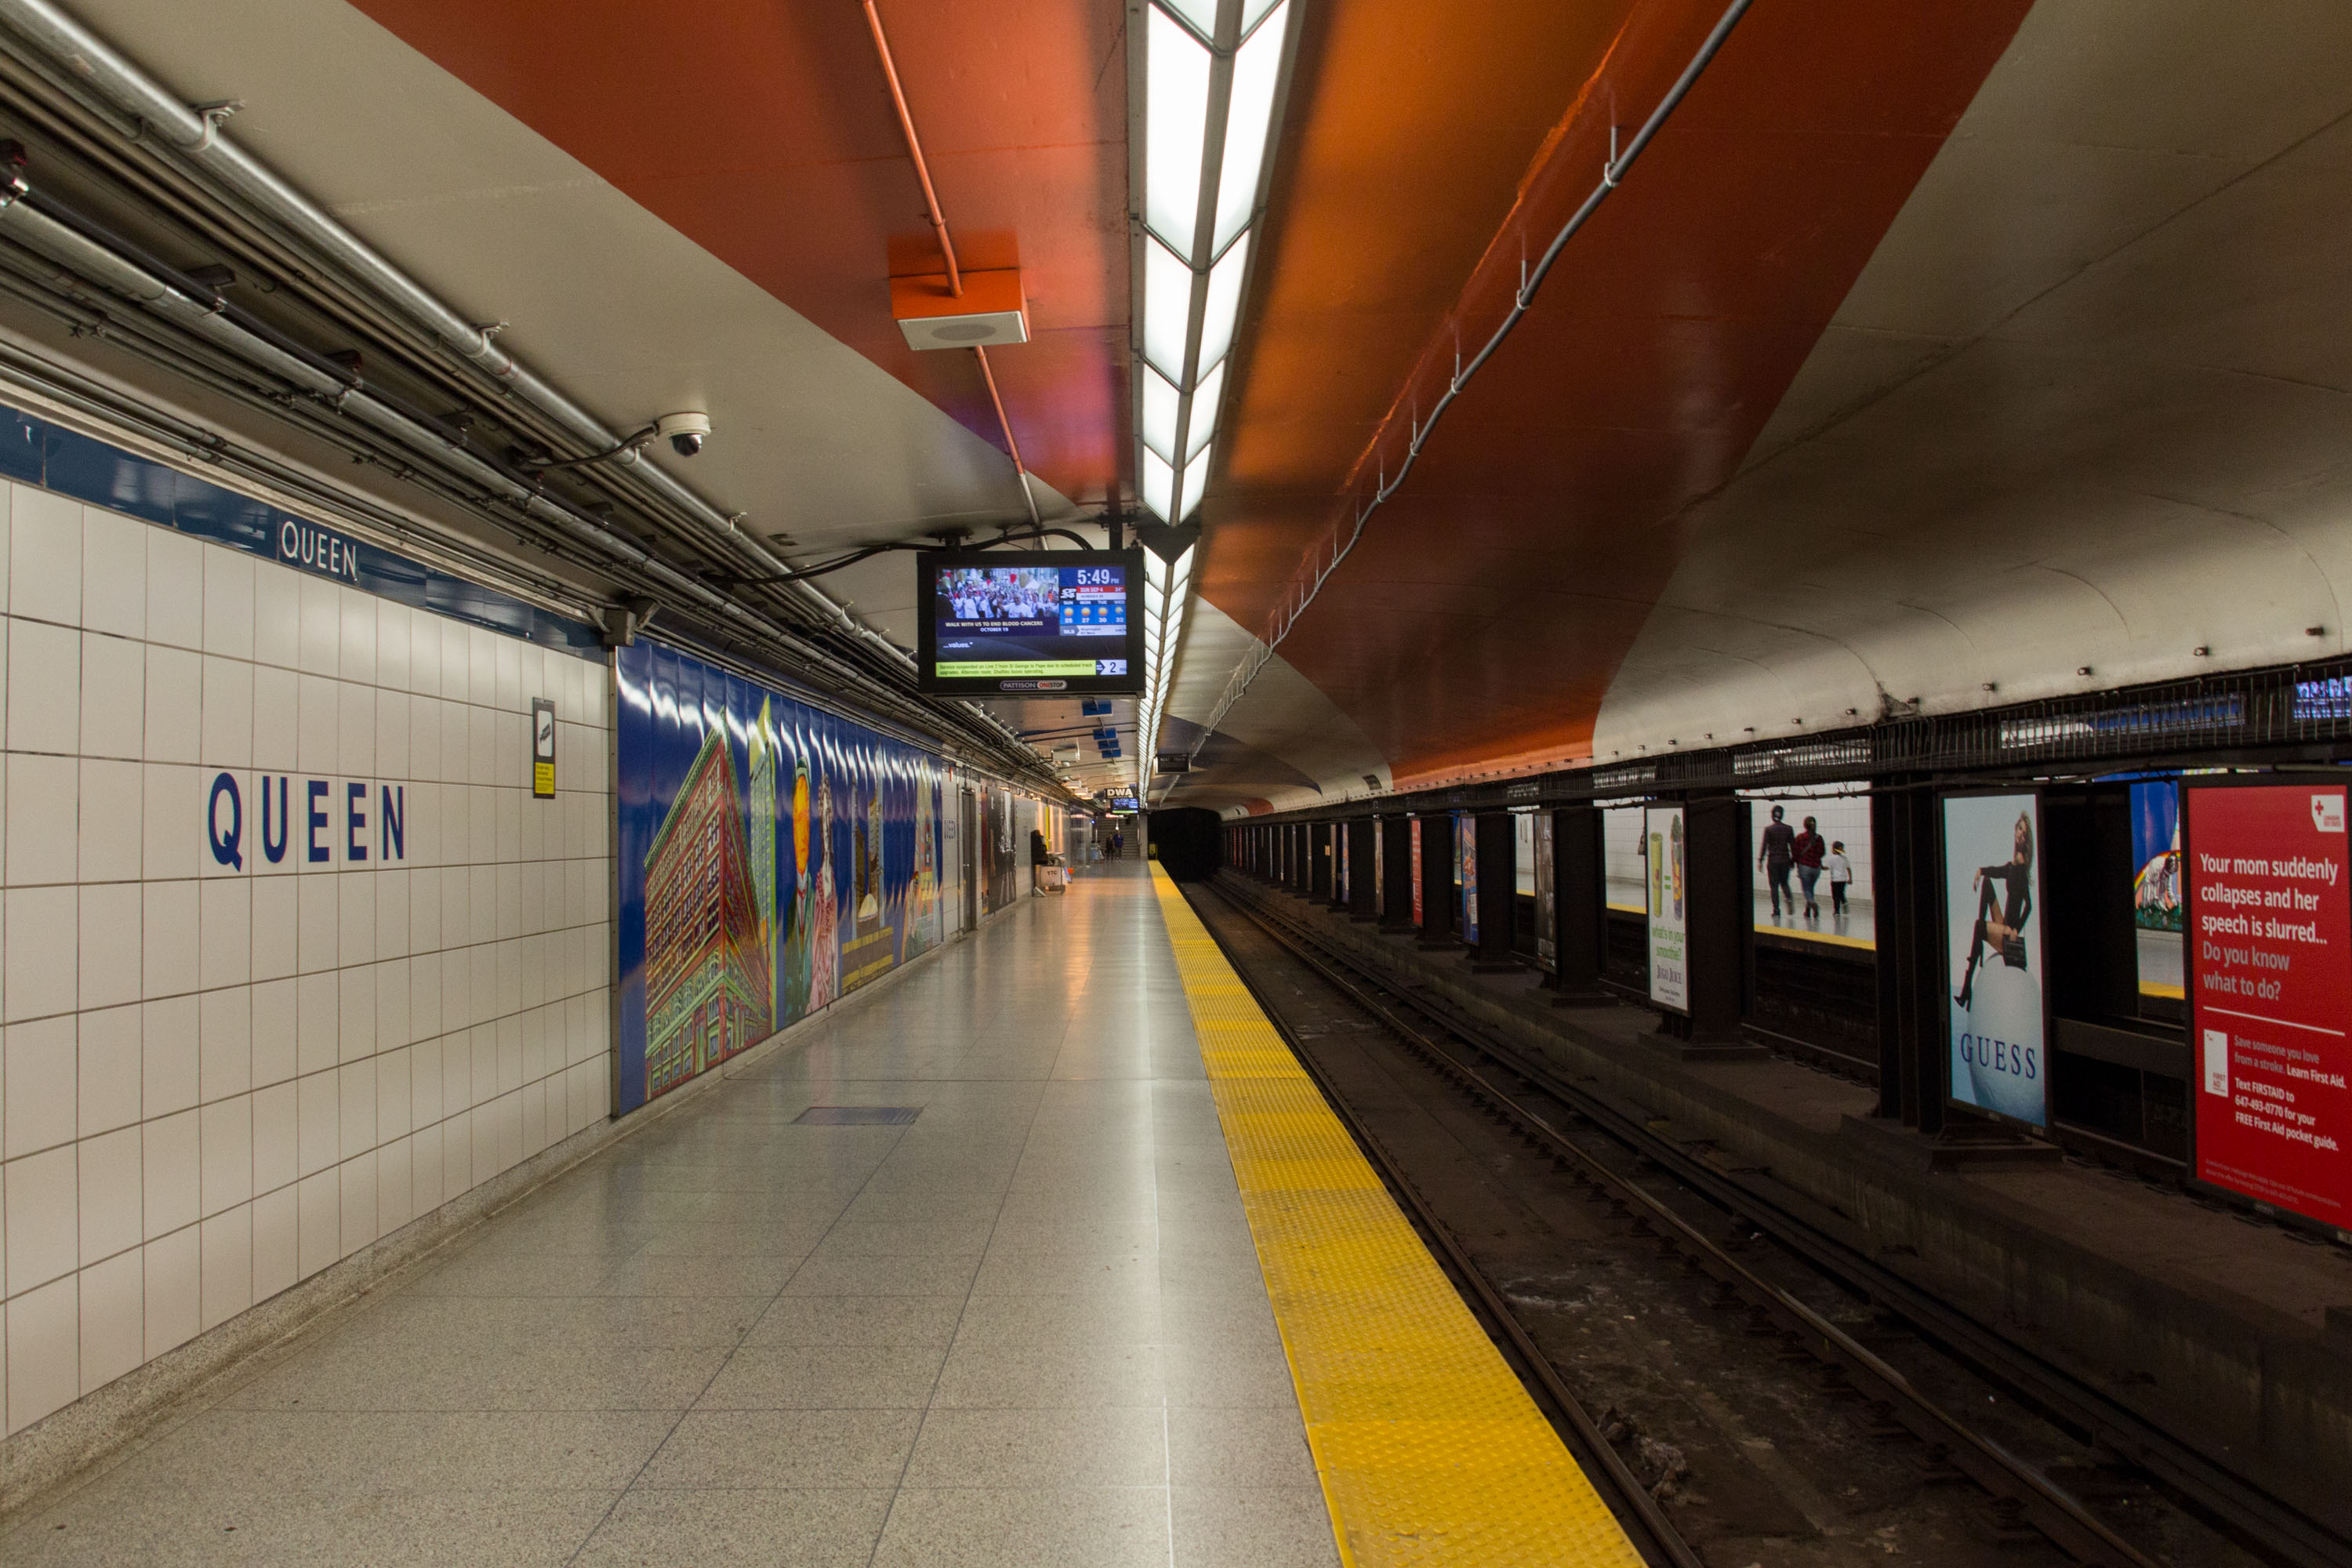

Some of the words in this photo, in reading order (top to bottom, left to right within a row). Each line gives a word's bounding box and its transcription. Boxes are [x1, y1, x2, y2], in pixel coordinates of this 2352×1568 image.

[281, 521, 357, 580] QUEEN
[1077, 569, 1110, 585] 5:49
[1110, 662, 1116, 673] 2
[1107, 789, 1134, 798] DWA
[208, 772, 404, 872] QUEEN
[2200, 853, 2230, 873] Your
[2234, 858, 2269, 877] mom
[2272, 856, 2338, 886] suddenly
[2201, 882, 2261, 909] collapses
[2264, 887, 2291, 909] and
[2295, 888, 2319, 911] her
[2201, 914, 2248, 936] speech
[2252, 916, 2263, 936] is
[2266, 917, 2327, 944] slurred...
[2203, 941, 2220, 960] Do
[2223, 947, 2249, 967] you
[2252, 946, 2289, 971] know
[2203, 971, 2237, 993] what
[2241, 977, 2254, 996] to
[2258, 978, 2281, 1000] do?
[1961, 1033, 2036, 1080] GUESS
[2235, 1036, 2251, 1049] Save
[2252, 1041, 2286, 1057] someone
[2287, 1047, 2301, 1060] you
[2303, 1049, 2320, 1064] love
[2235, 1053, 2252, 1066] from
[2254, 1058, 2258, 1068] a
[2259, 1058, 2285, 1074] stroke.
[2287, 1064, 2309, 1080] Learn
[2310, 1069, 2328, 1084] First
[2330, 1074, 2347, 1089] Aid.
[2235, 1077, 2251, 1091] Text
[2252, 1081, 2285, 1101] FIRSTAID
[2286, 1091, 2295, 1103] to
[2235, 1094, 2283, 1118] 647-493-0770
[2285, 1107, 2296, 1120] for
[2297, 1112, 2316, 1126] your
[2235, 1112, 2252, 1126] FREE
[2254, 1116, 2270, 1132] First
[2272, 1122, 2285, 1136] Aid
[2286, 1127, 2313, 1144] pocket
[2314, 1135, 2339, 1151] guide.
